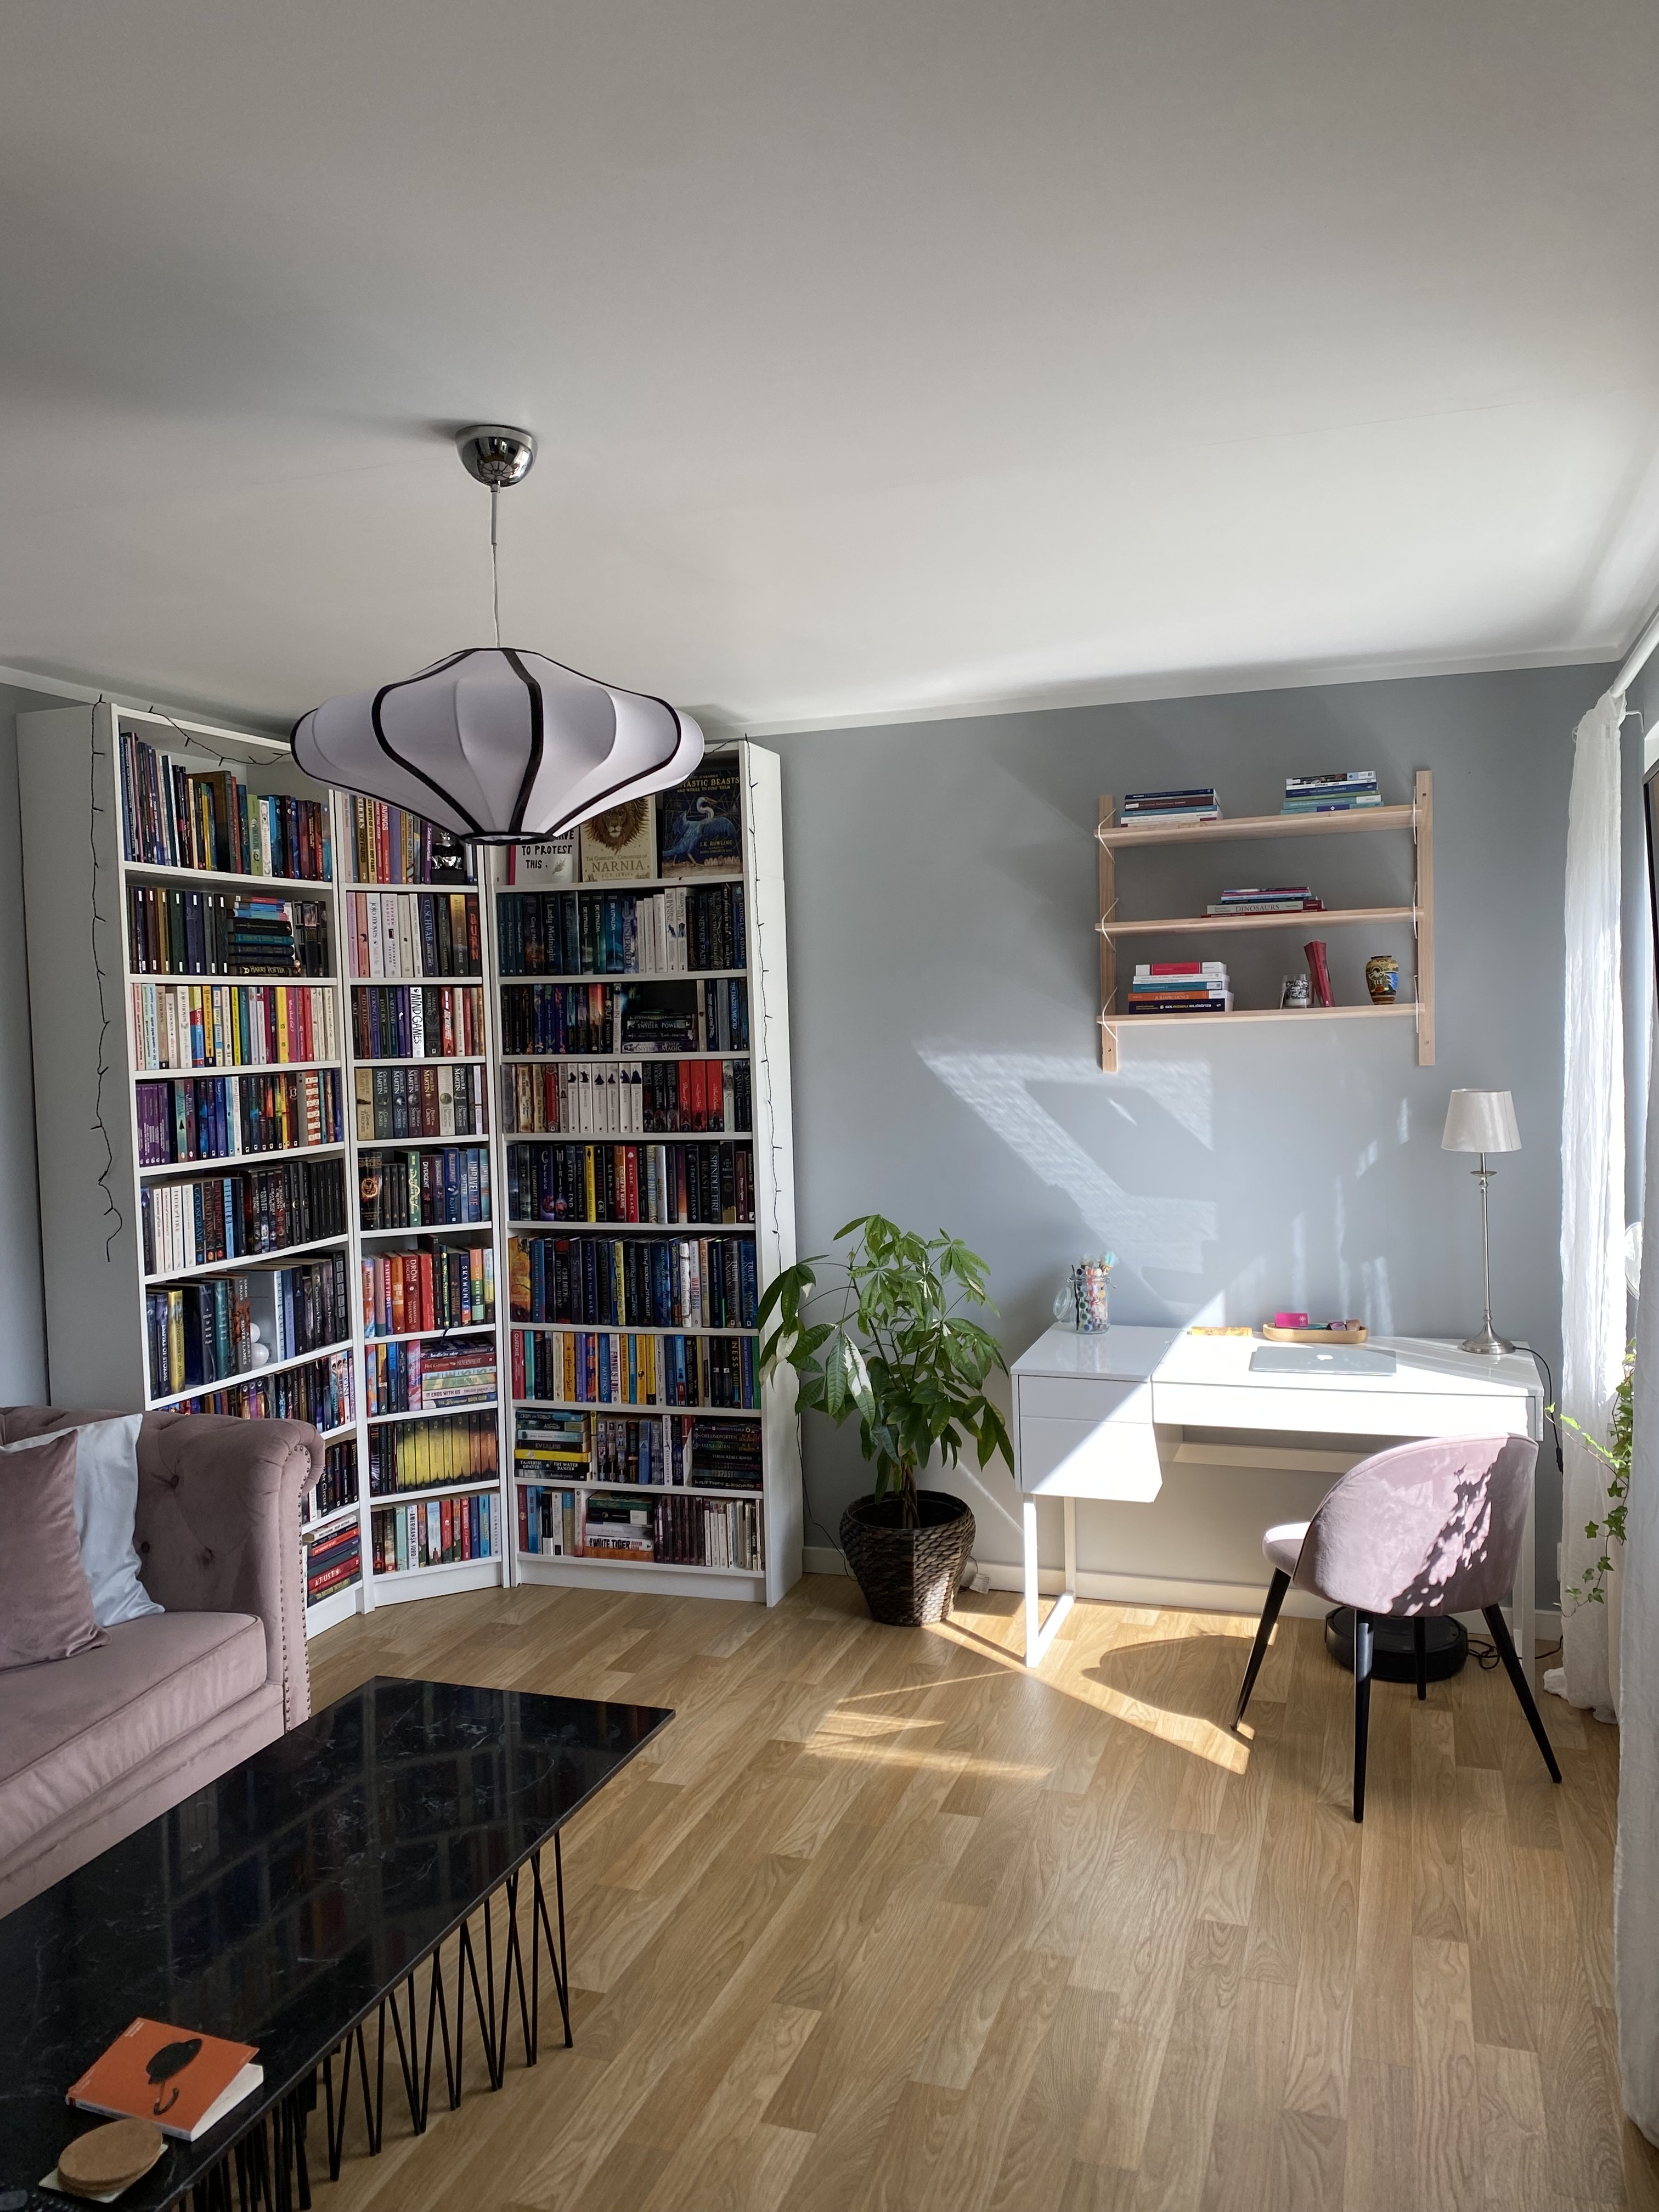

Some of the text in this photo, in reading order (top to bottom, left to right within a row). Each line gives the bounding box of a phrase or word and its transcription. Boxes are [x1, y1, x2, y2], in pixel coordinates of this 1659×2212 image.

[522, 845, 572, 855] TO PROTEST
[592, 860, 645, 872] NARNIA
[425, 911, 433, 941] SCHWAB
[546, 904, 555, 962] Lady Midnight
[411, 1015, 422, 1044] GAMES
[691, 1278, 699, 1310] WARCROSS
